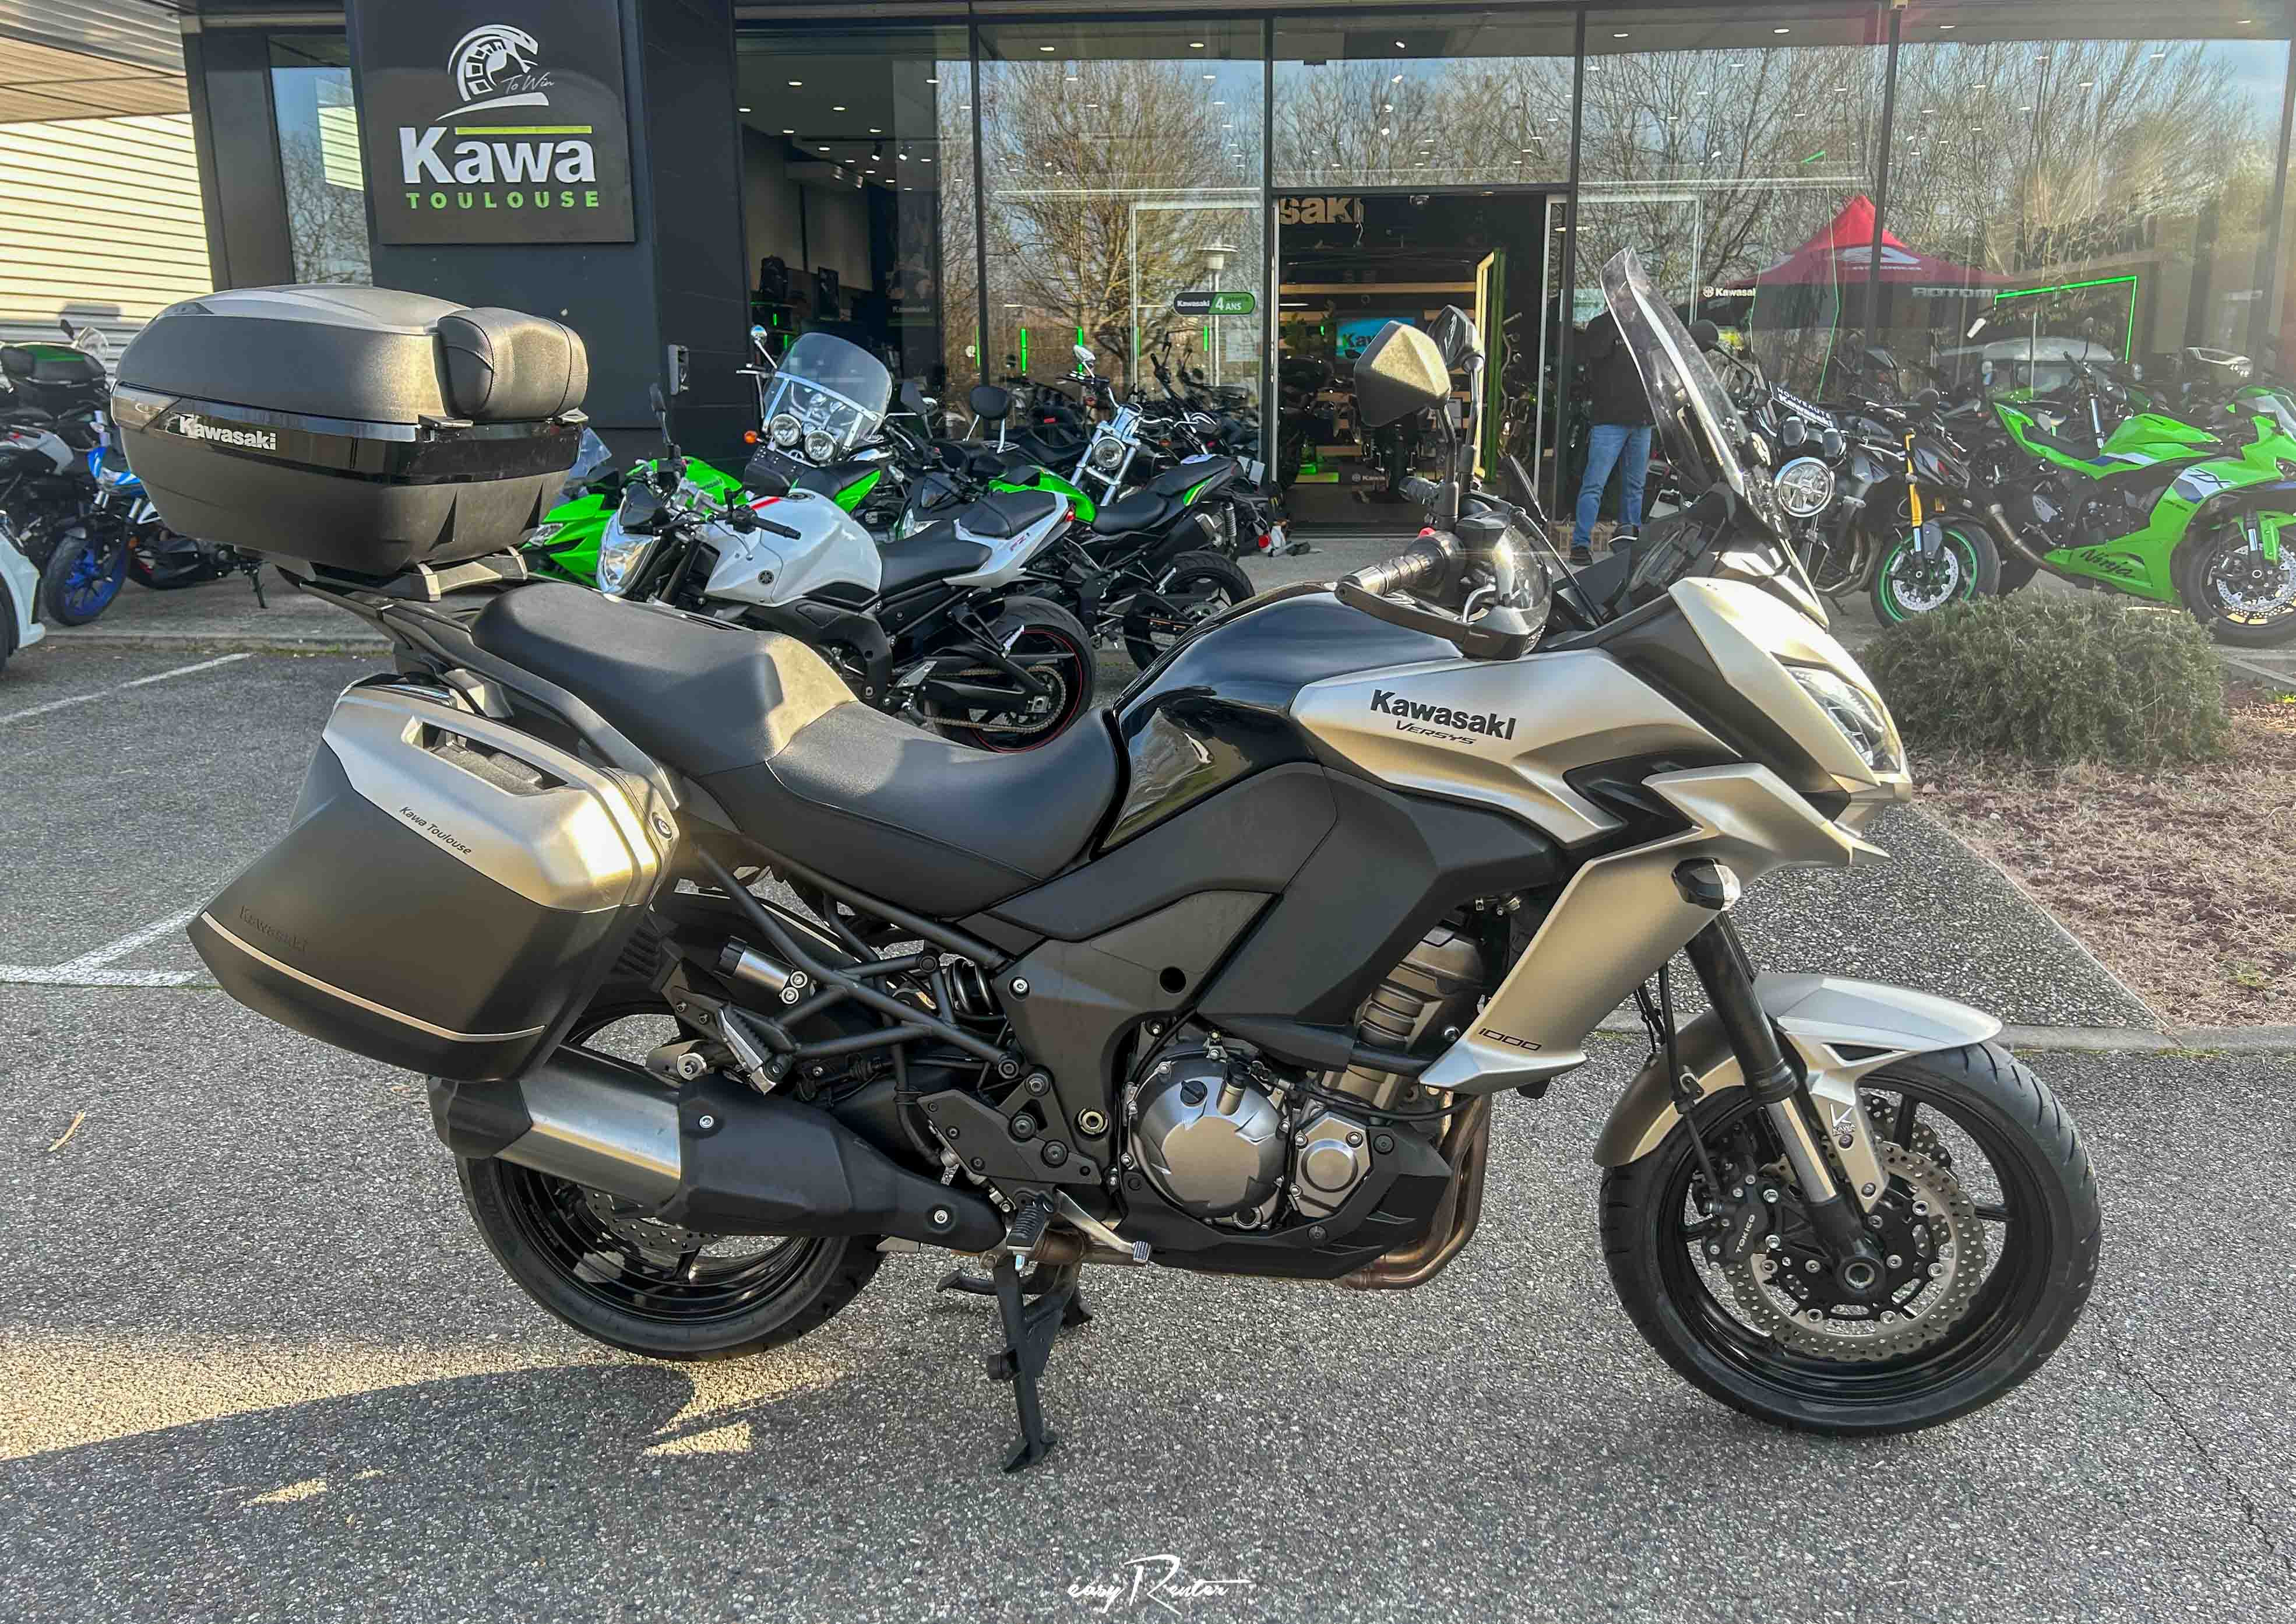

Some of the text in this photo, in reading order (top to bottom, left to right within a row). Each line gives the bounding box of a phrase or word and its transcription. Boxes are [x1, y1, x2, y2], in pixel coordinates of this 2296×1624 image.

[501, 71, 555, 94] To Win
[399, 126, 597, 184] Kawa
[406, 191, 599, 209] TOULOUSE
[1215, 297, 1224, 310] 4
[1226, 302, 1242, 310] ANS
[179, 415, 276, 451] Kawasaki
[2079, 549, 2135, 579] Ninja
[1371, 689, 1517, 740] Kawasaki
[400, 807, 471, 854] Kawa Toulouse
[1478, 1028, 1542, 1050] 1000
[1735, 1214, 1756, 1253] TOKICO
